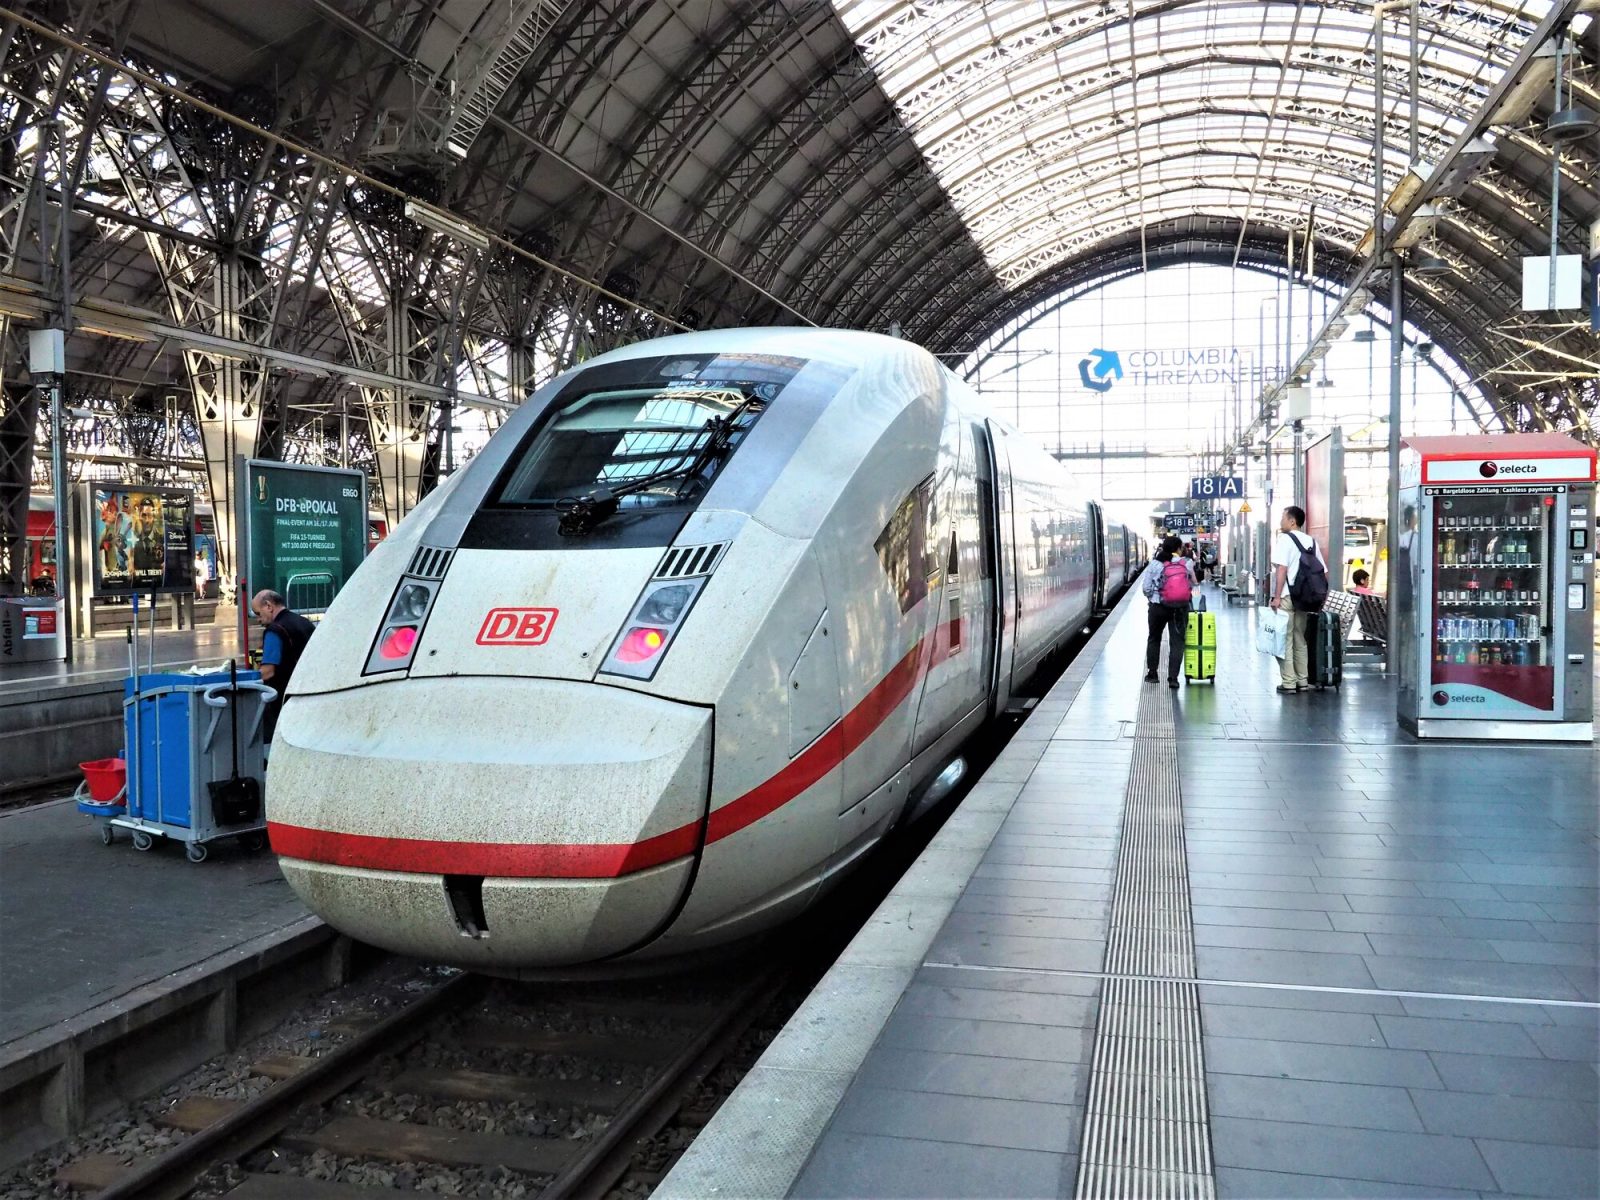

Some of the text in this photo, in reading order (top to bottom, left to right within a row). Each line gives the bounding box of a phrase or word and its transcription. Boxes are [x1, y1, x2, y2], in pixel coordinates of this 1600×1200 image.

[1129, 348, 1241, 368] COLUMBIA
[1130, 365, 1291, 386] THREADNEEDL
[1500, 464, 1537, 474] selecta
[342, 488, 358, 498] ERGO
[1194, 478, 1237, 494] 18 A
[276, 498, 338, 514] DFB-ePOKAL
[486, 613, 546, 639] DB
[3, 620, 13, 655] Abfall
[1451, 694, 1486, 703] selecta
